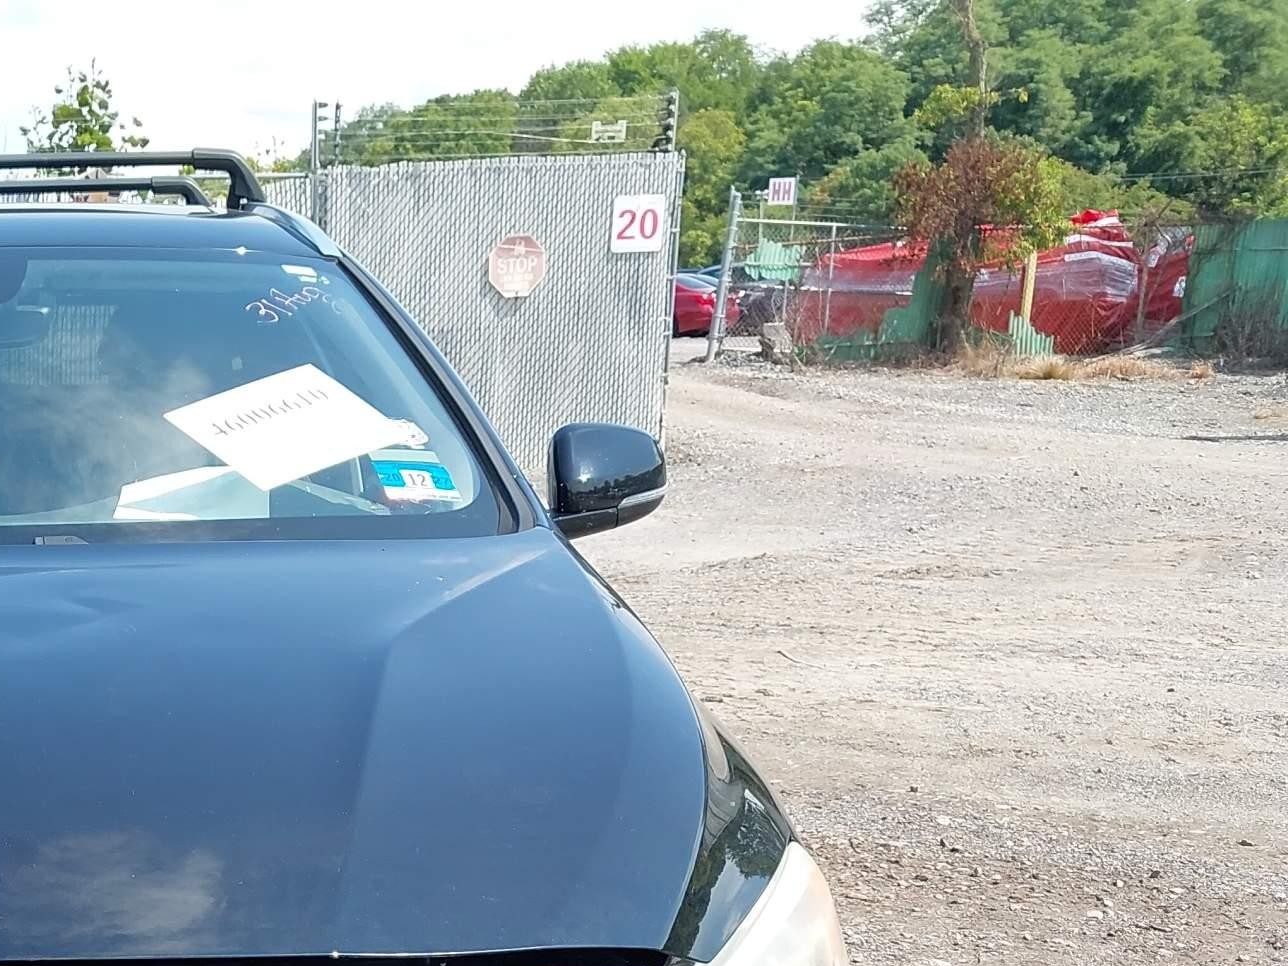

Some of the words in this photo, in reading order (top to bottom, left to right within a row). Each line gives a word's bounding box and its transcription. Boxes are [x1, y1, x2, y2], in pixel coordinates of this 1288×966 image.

[772, 181, 792, 201] HH
[616, 208, 659, 240] 20
[497, 256, 538, 274] STOP
[408, 473, 428, 486] 12
